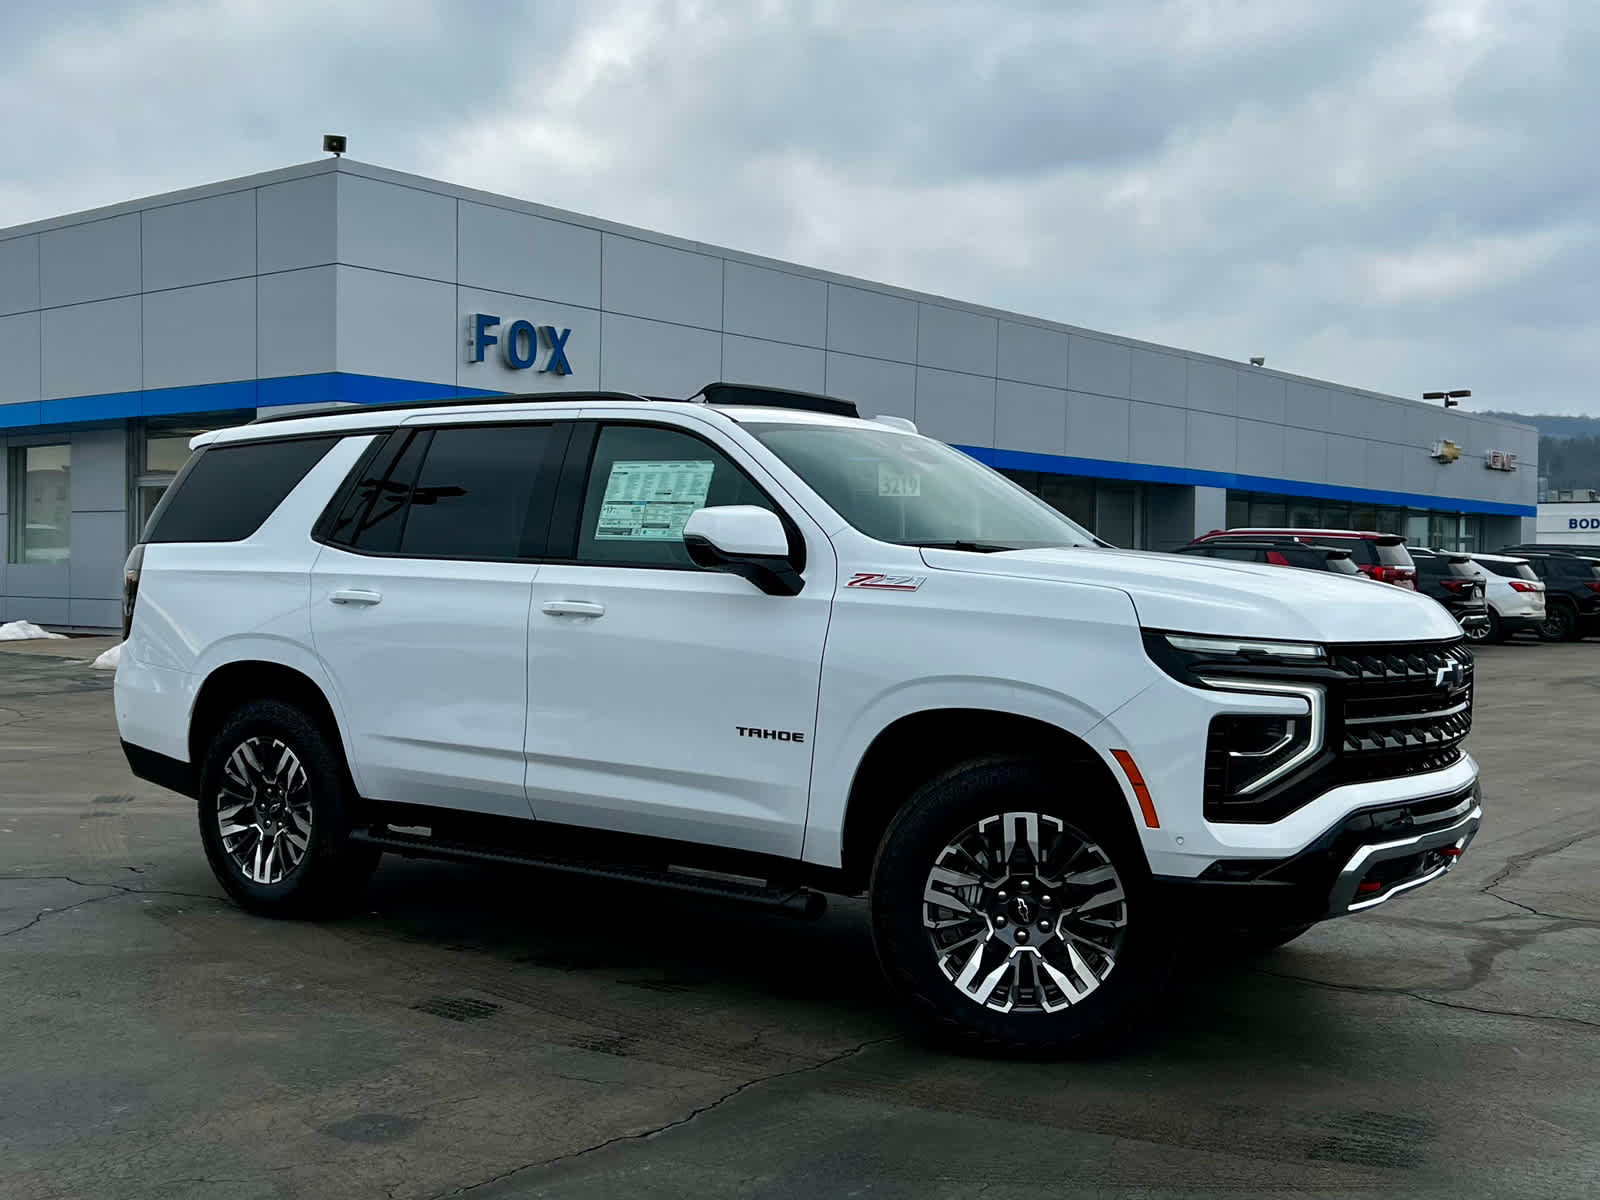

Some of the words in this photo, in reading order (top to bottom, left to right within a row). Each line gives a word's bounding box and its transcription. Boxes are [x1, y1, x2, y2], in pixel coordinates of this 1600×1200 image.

[472, 313, 573, 376] FOX
[1569, 518, 1600, 529] BOD
[736, 726, 805, 743] TAHOE
